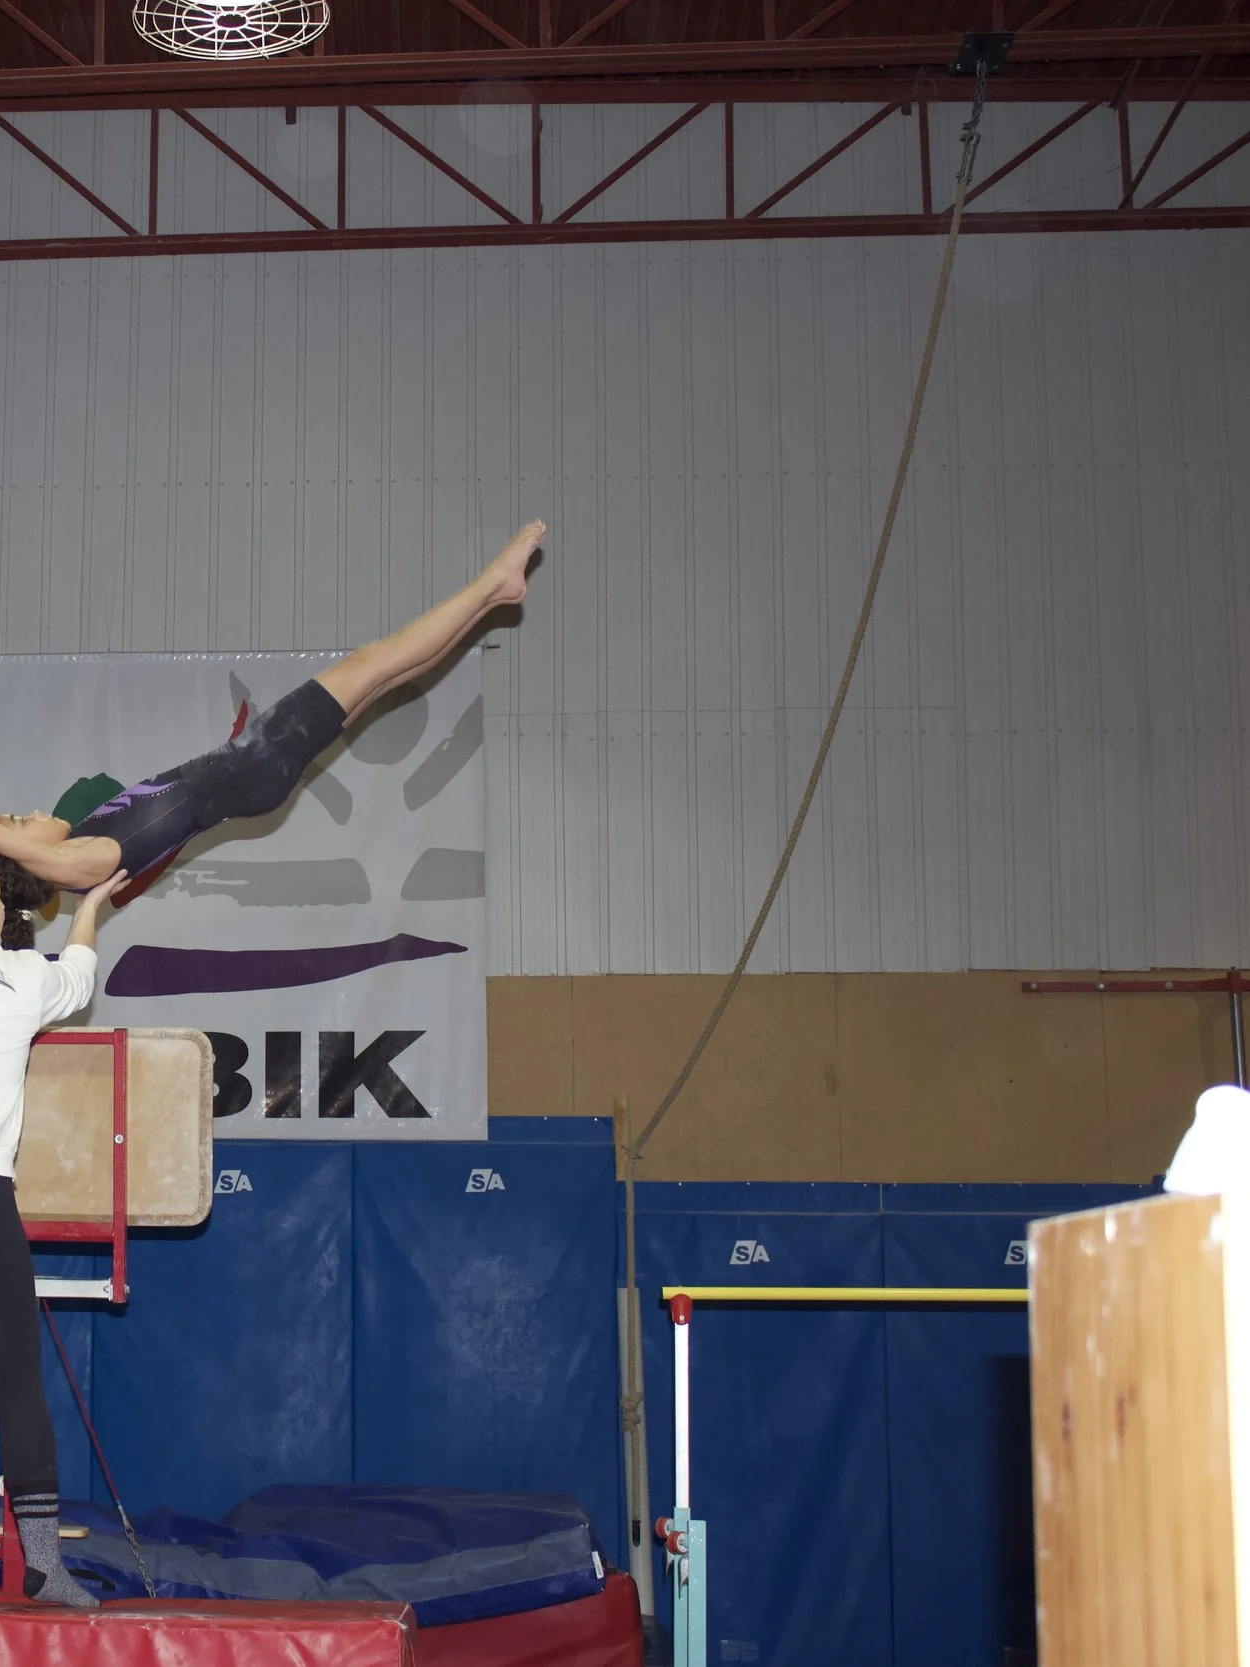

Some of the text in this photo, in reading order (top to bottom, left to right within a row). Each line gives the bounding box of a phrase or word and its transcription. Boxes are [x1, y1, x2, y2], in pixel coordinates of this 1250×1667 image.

[214, 1170, 253, 1194] SA
[466, 1169, 506, 1192] SA
[730, 1241, 770, 1265] SA
